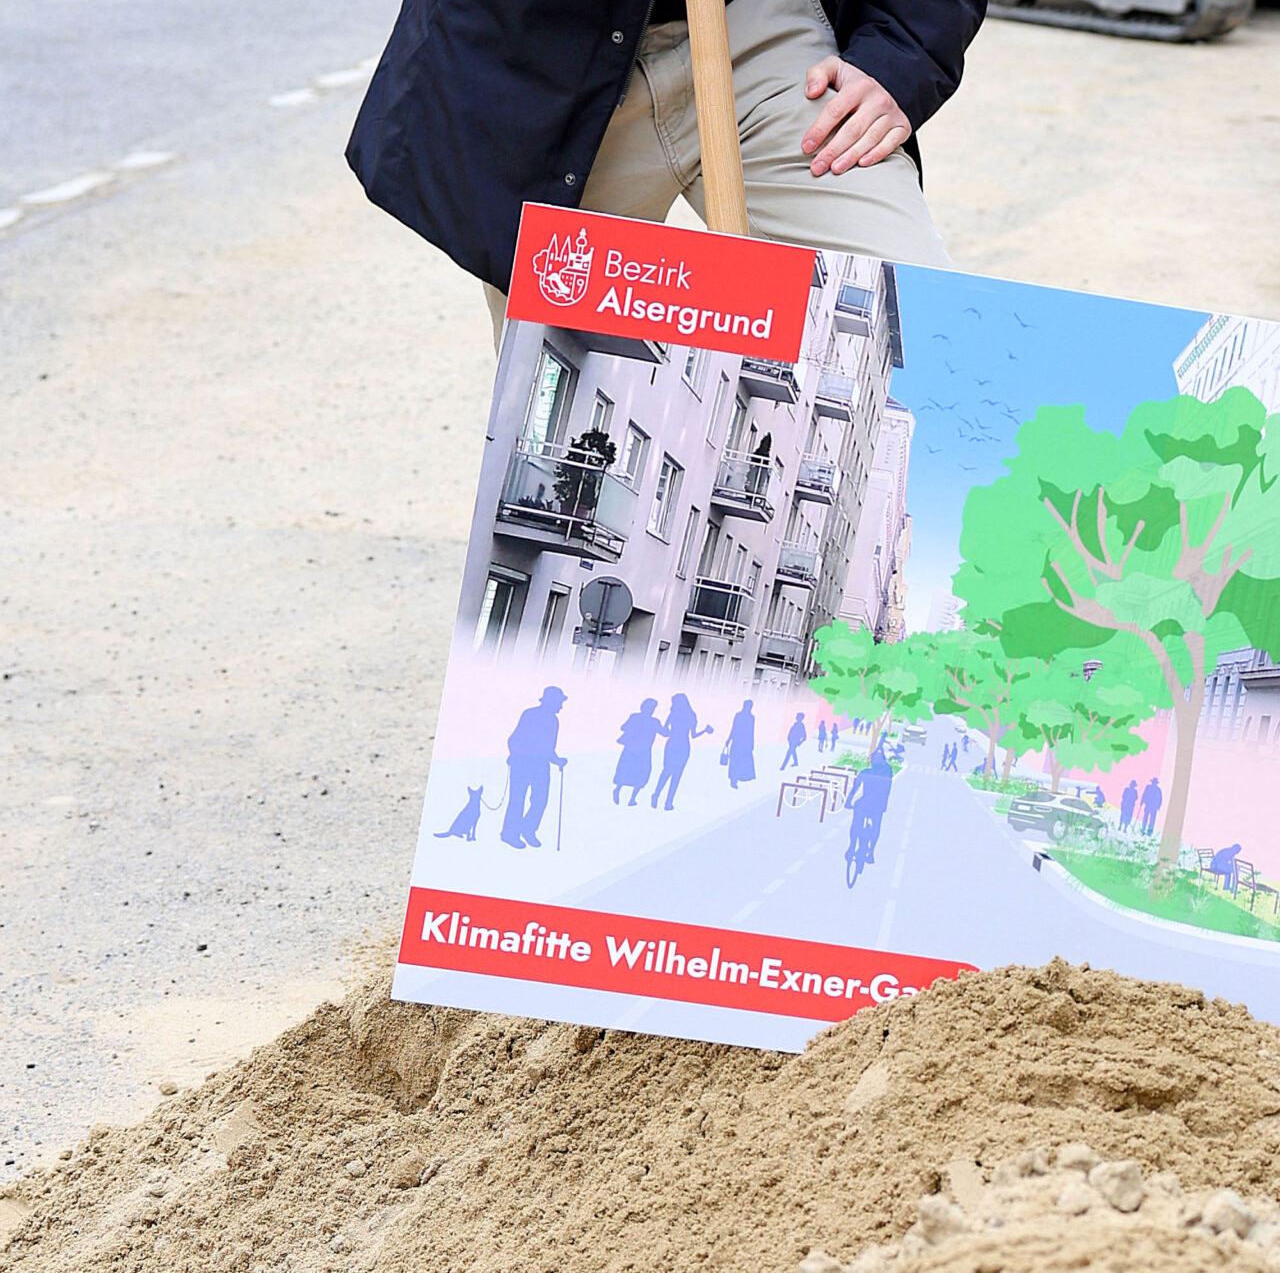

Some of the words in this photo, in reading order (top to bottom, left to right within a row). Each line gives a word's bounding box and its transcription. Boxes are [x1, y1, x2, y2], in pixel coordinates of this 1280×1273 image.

[604, 248, 693, 290] Bezirk
[596, 285, 774, 339] Alsergrund
[420, 911, 592, 963] Klimafitte
